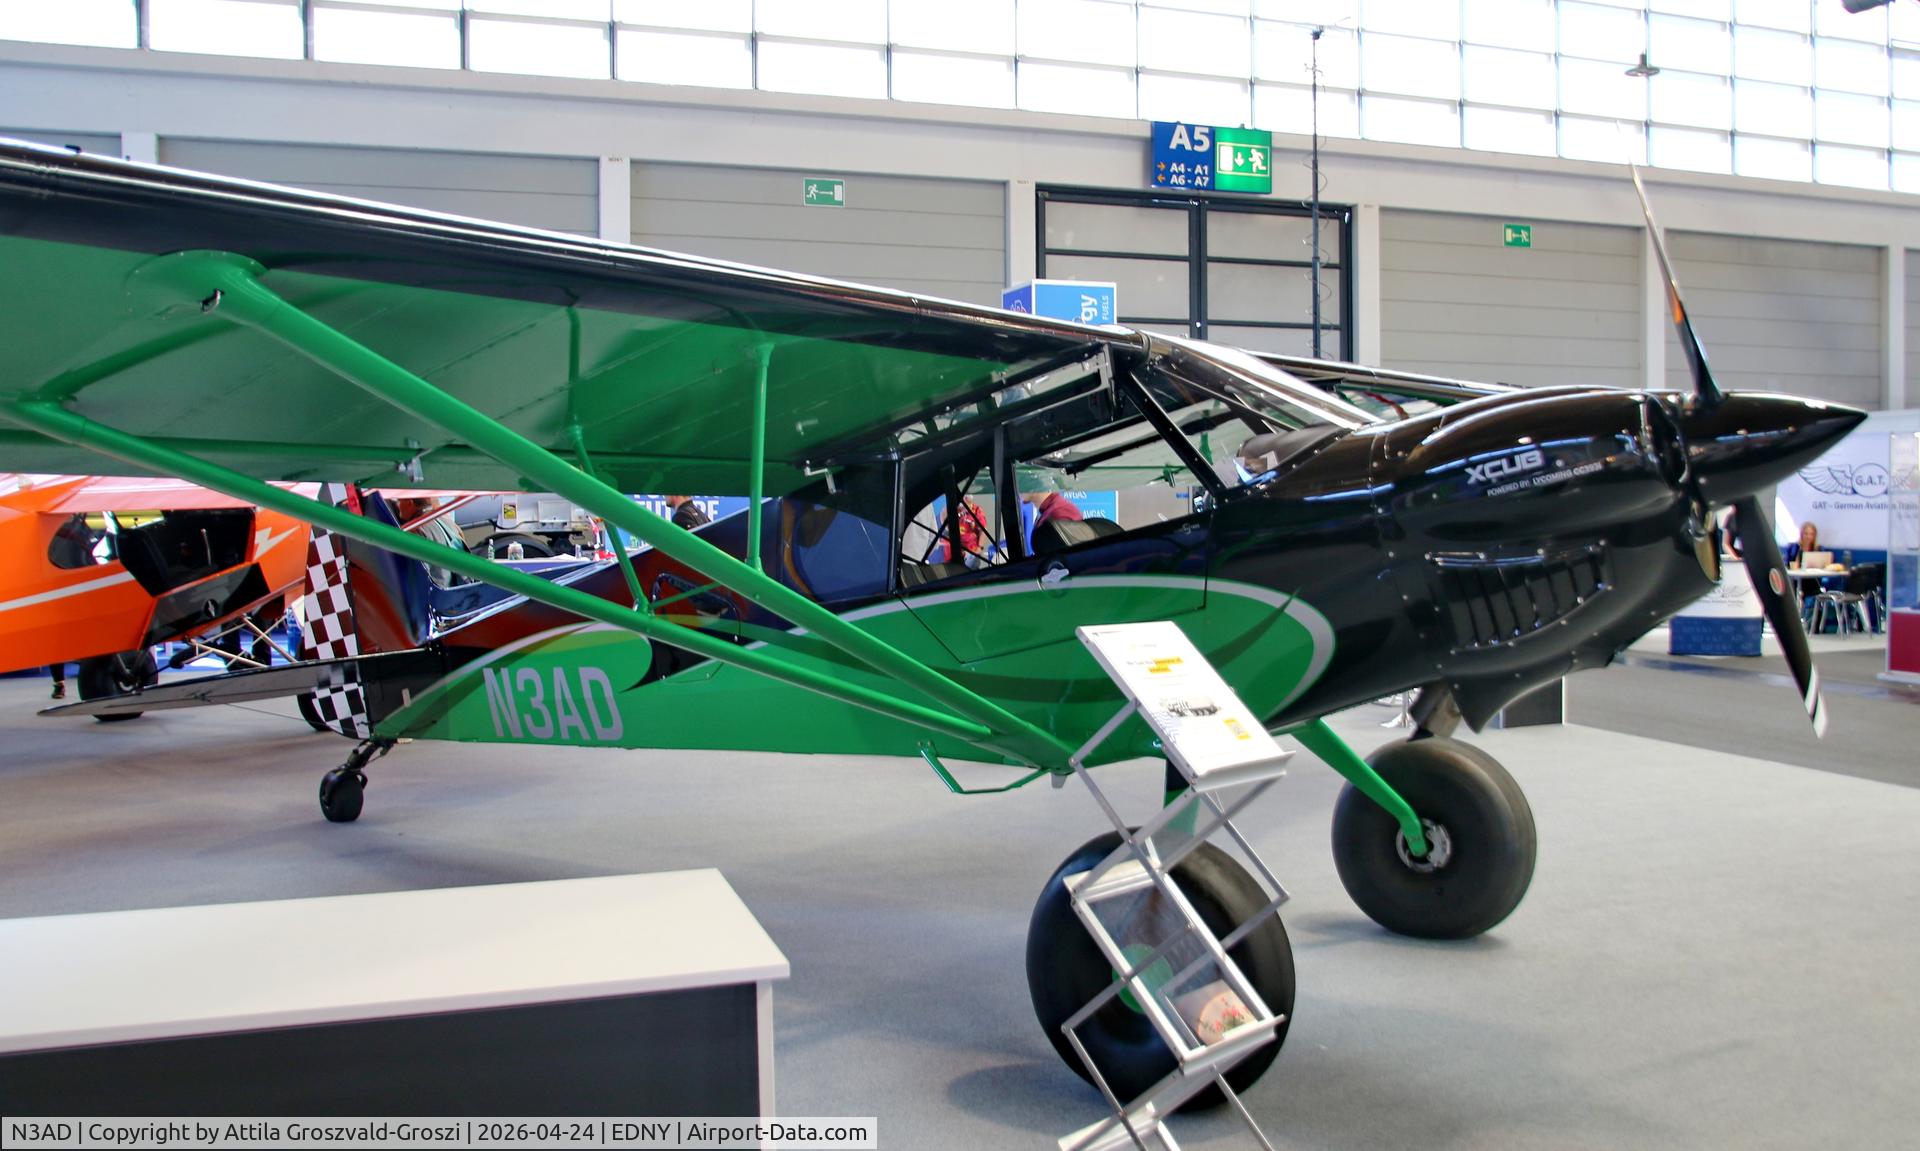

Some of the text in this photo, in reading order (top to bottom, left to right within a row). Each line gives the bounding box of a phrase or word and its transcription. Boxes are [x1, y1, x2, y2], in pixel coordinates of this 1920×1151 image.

[1169, 125, 1210, 152] A5
[1170, 163, 1185, 174] A4
[1194, 165, 1209, 175] A1
[1170, 174, 1186, 185] A6
[1194, 176, 1209, 187] A7
[1081, 294, 1098, 324] gy
[1101, 295, 1109, 320] FUELS
[1465, 450, 1543, 484] XCUB
[1855, 475, 1885, 486] G.A.T.
[1487, 483, 1519, 497] POWERED
[1532, 469, 1573, 486] LYCOMING
[483, 667, 624, 740] N3AD
